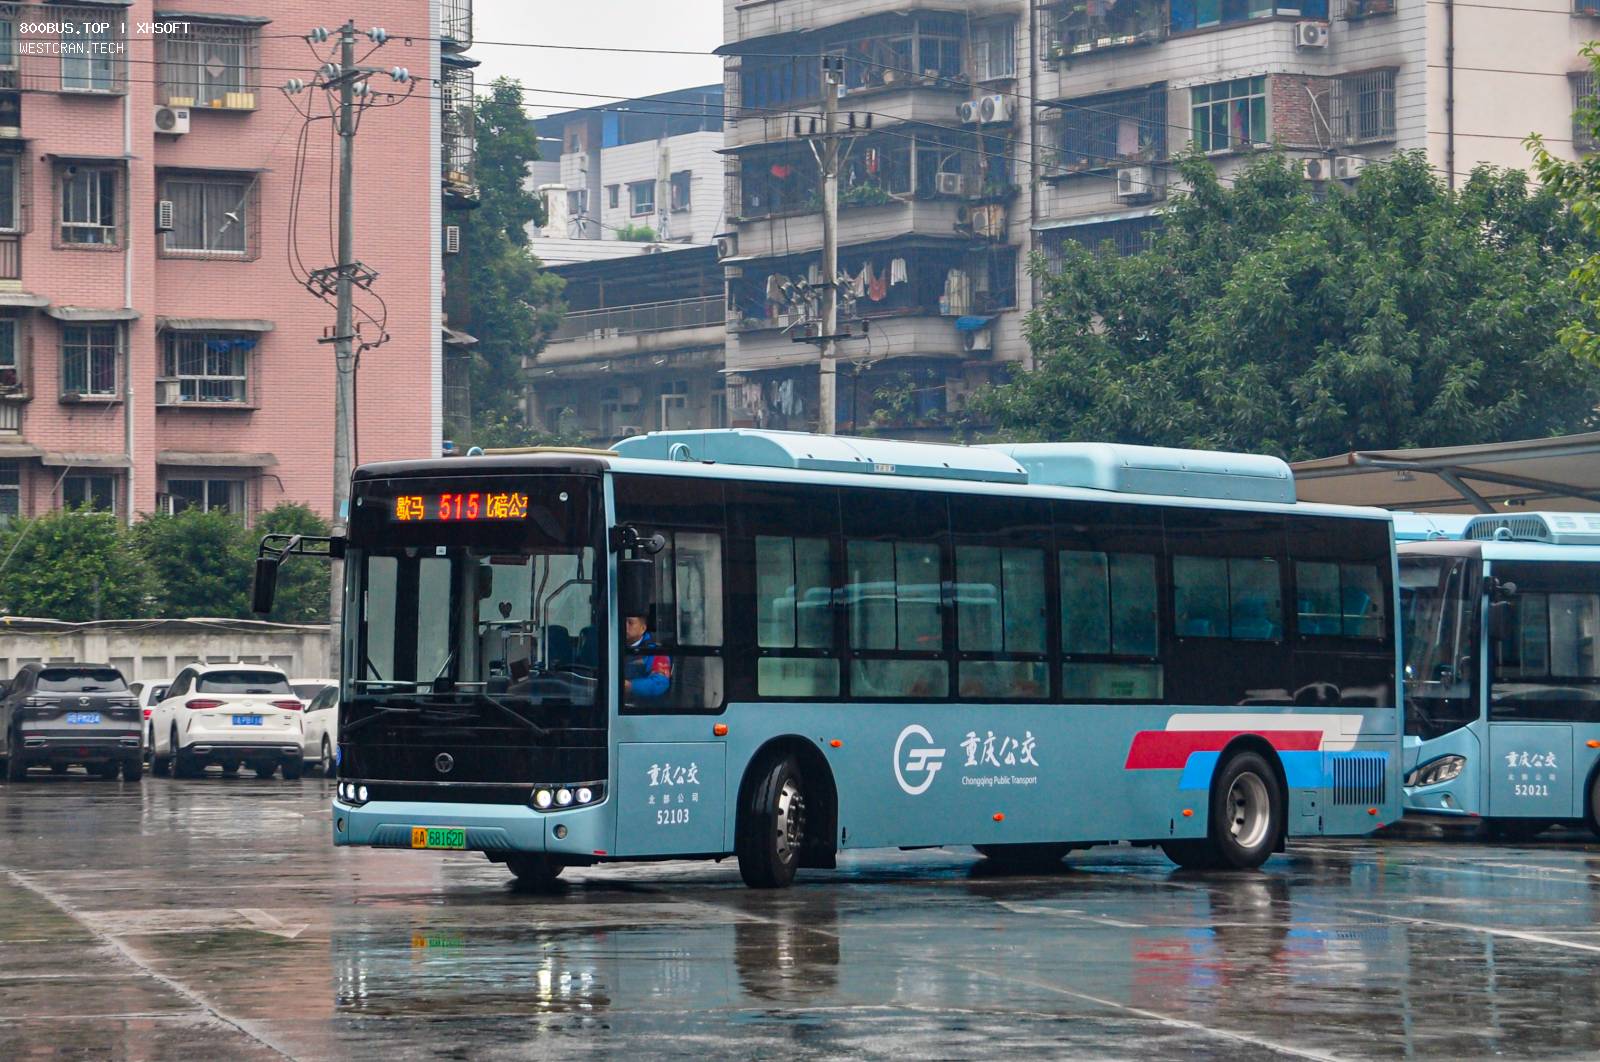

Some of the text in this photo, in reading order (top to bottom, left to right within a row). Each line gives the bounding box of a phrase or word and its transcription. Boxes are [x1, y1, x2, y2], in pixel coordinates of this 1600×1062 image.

[396, 496, 424, 520] 歇马
[439, 493, 480, 520] 515
[960, 730, 1039, 767] 重庆公交
[1504, 751, 1558, 768] 重庆公交
[647, 762, 700, 786] 重庆公交
[961, 775, 1037, 787] Chongqing Public Transport
[1515, 784, 1549, 796] 52021
[657, 808, 690, 825] 52103
